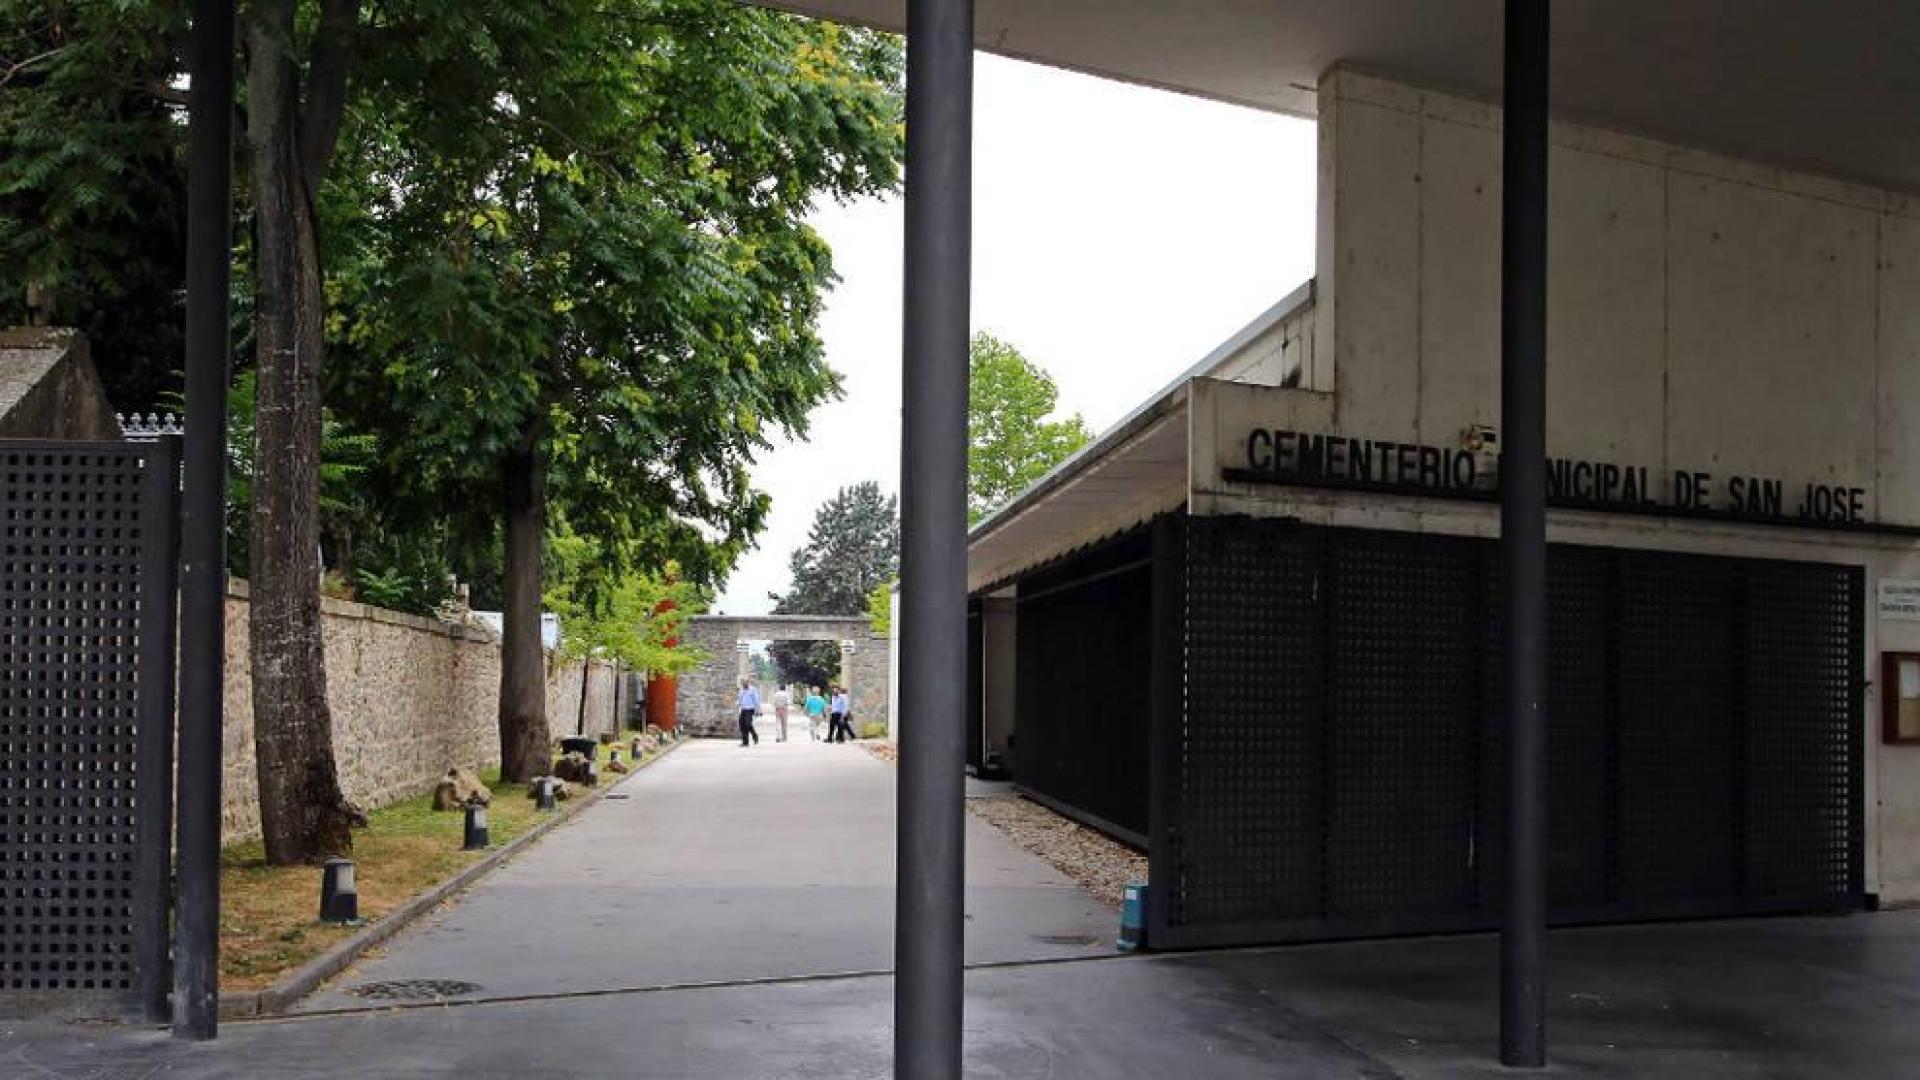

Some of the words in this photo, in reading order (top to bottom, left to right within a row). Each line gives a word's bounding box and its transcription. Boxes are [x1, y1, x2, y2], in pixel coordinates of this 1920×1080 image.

[1248, 428, 1476, 489] CEMENTERIO
[1498, 454, 1655, 507] NICIPAL
[1675, 470, 1711, 511] DE
[1728, 475, 1783, 517] SAN
[1799, 482, 1866, 527] JOSE
